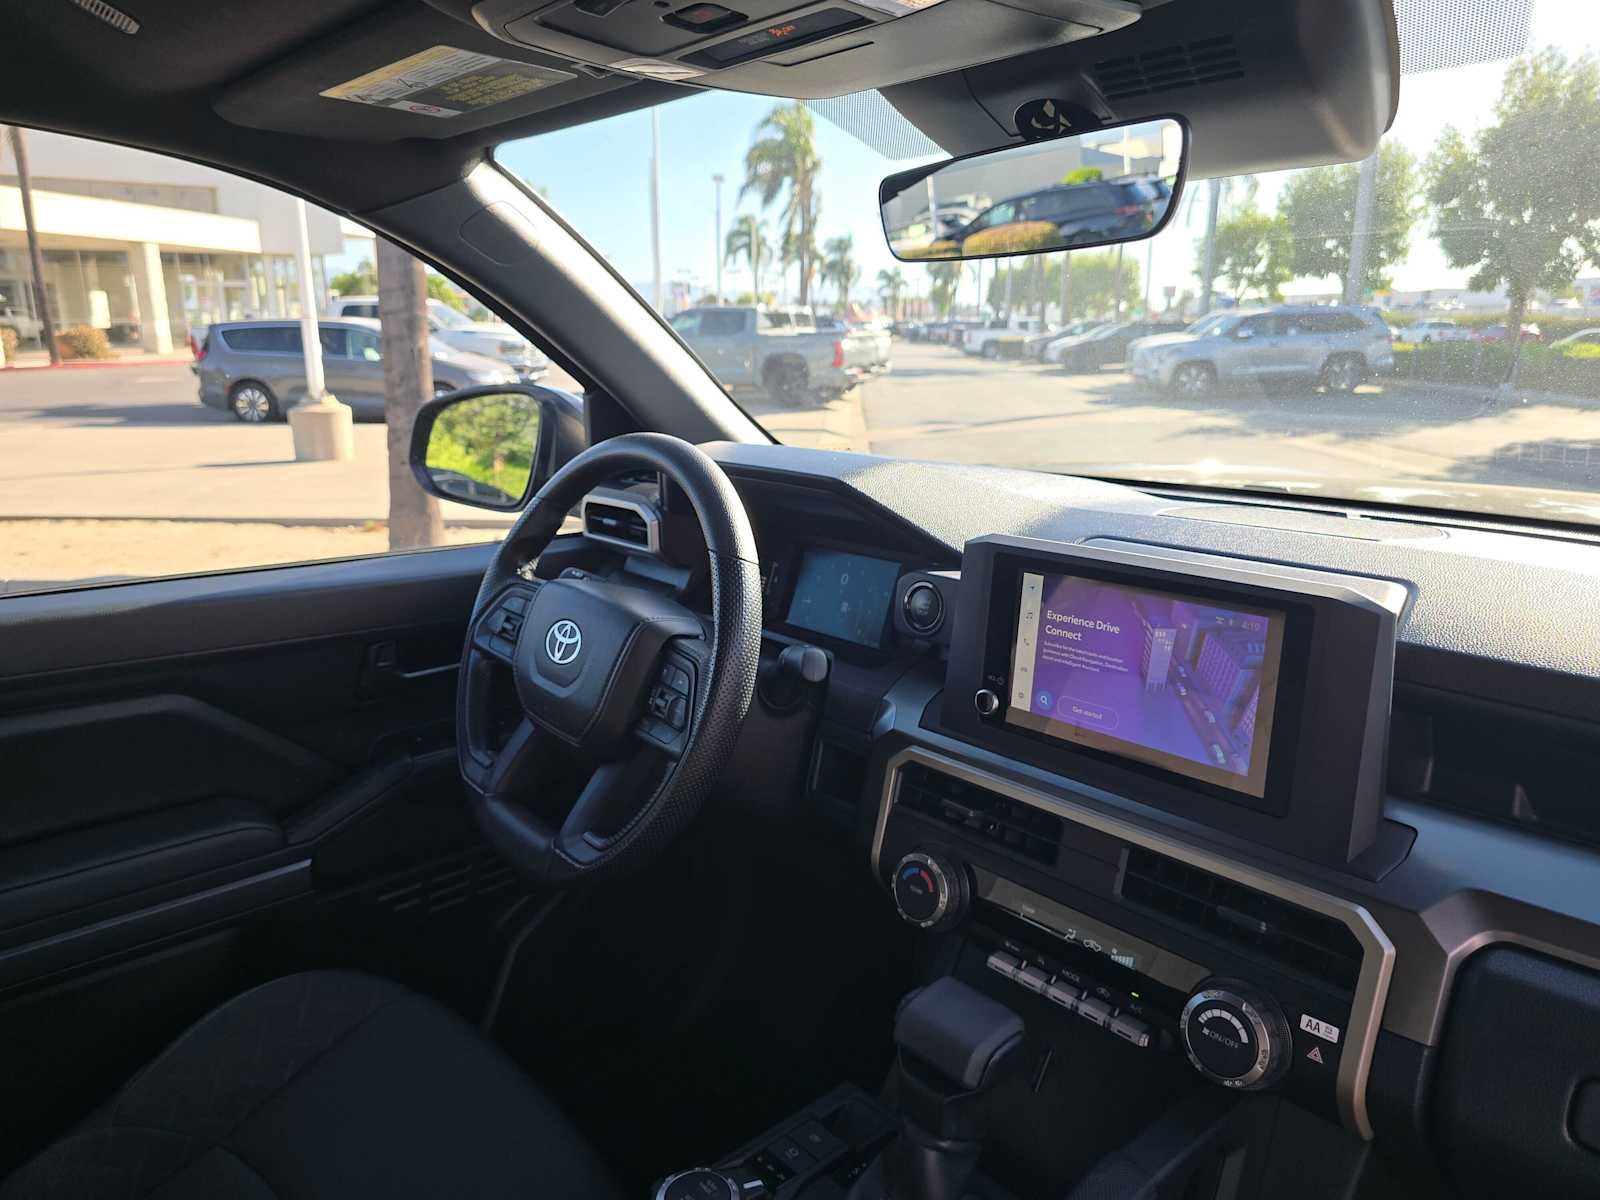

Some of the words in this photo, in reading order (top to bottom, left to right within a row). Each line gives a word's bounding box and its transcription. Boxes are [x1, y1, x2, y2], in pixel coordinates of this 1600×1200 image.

[1047, 610, 1095, 628] Experience
[1095, 620, 1120, 634] Drive
[1045, 624, 1082, 641] Connect
[1305, 1018, 1320, 1034] AA
[1210, 1030, 1239, 1049] ON/OFF
